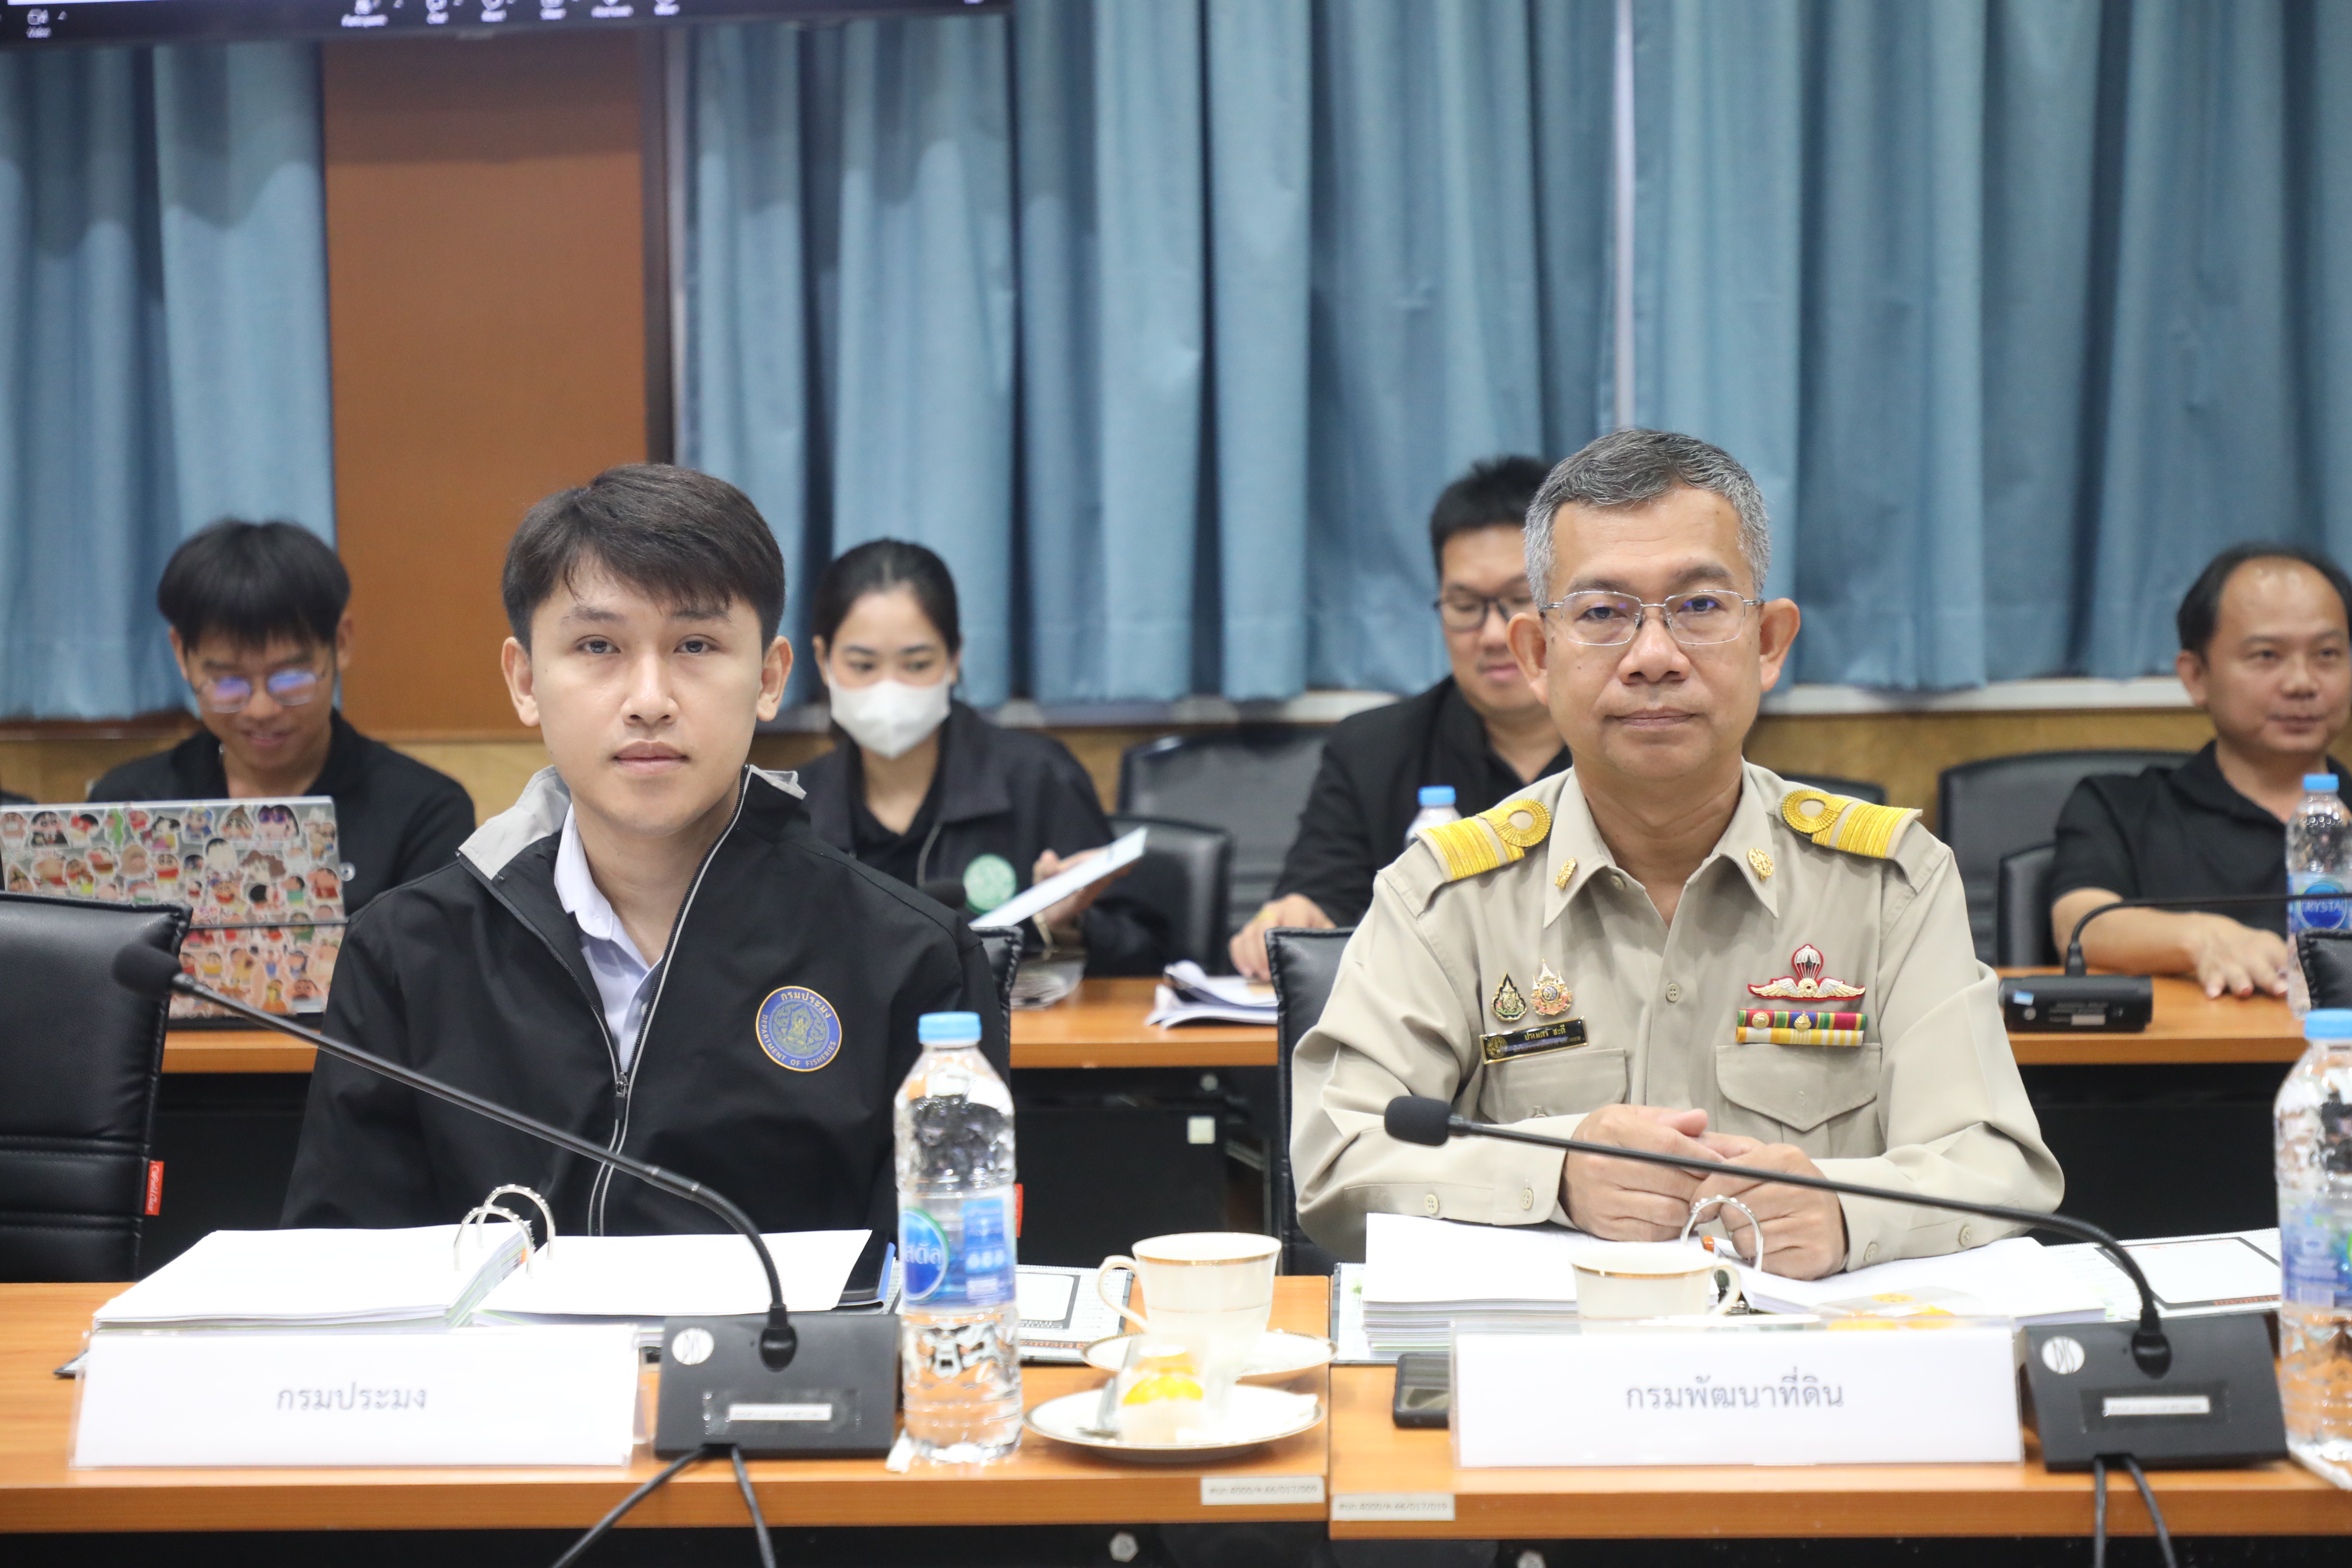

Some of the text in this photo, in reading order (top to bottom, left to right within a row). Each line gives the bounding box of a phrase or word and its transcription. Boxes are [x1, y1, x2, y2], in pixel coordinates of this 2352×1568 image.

[781, 992, 831, 1018] กรมประมง
[761, 1014, 787, 1061] DEPARTMENT
[806, 1041, 836, 1067] FISHERIES
[277, 1381, 426, 1410] กรมประมง
[1626, 1366, 1844, 1409] กรมพัฒนาที่ดิน
